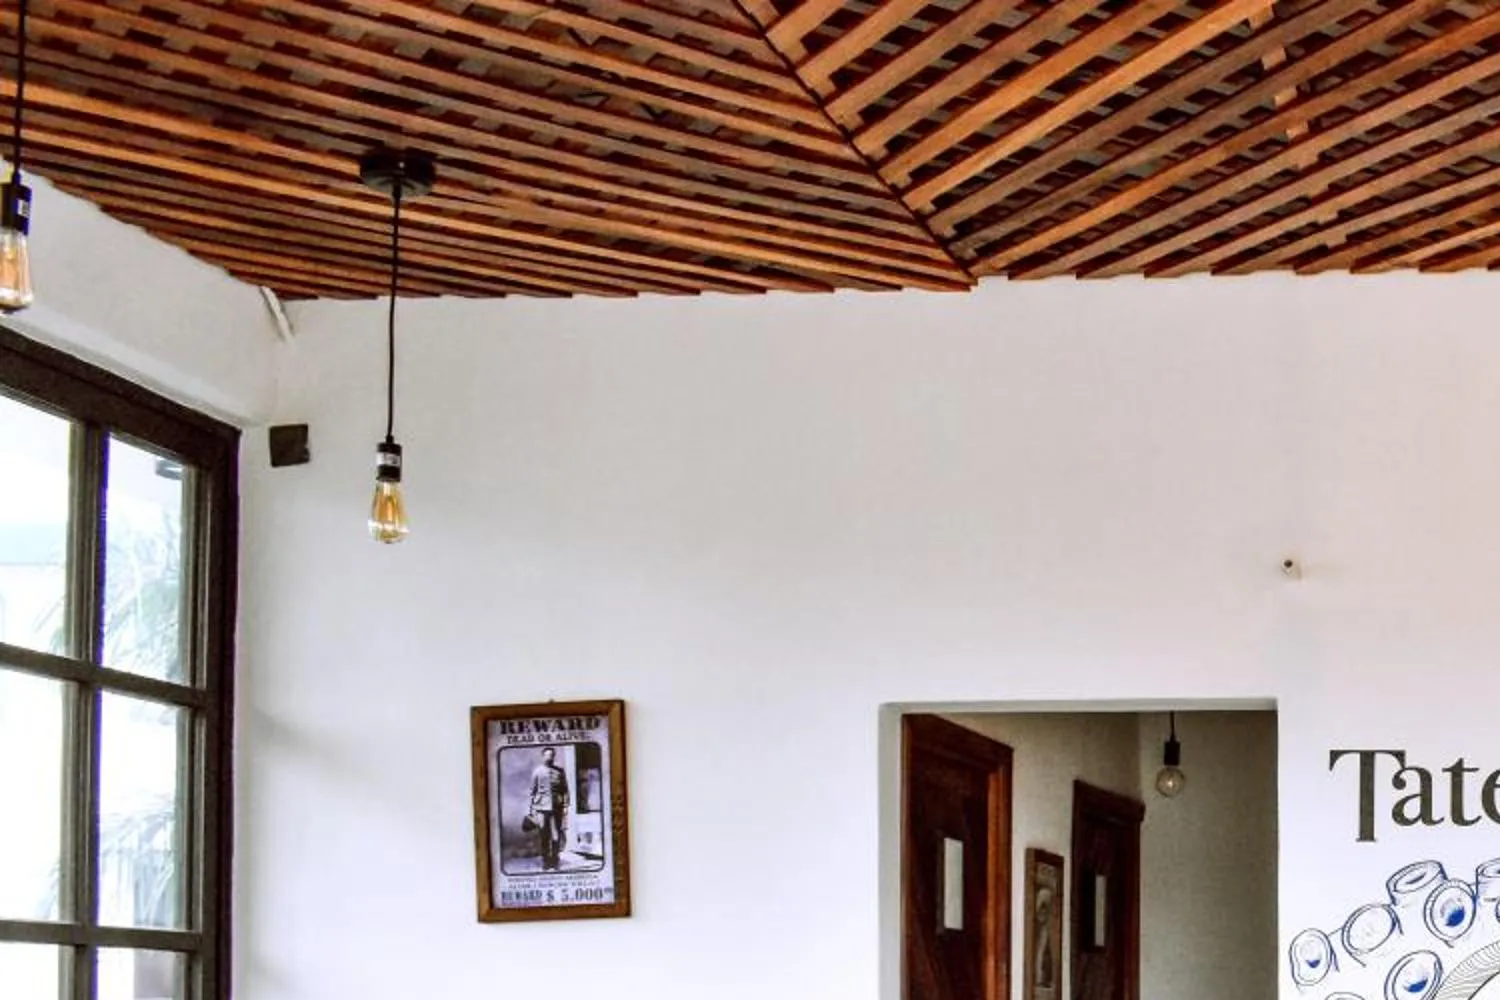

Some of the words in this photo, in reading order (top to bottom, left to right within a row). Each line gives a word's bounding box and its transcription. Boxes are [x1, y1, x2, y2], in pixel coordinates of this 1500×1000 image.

[500, 718, 600, 735] REWARD
[507, 734, 534, 744] DEAD
[538, 733, 552, 742] OR
